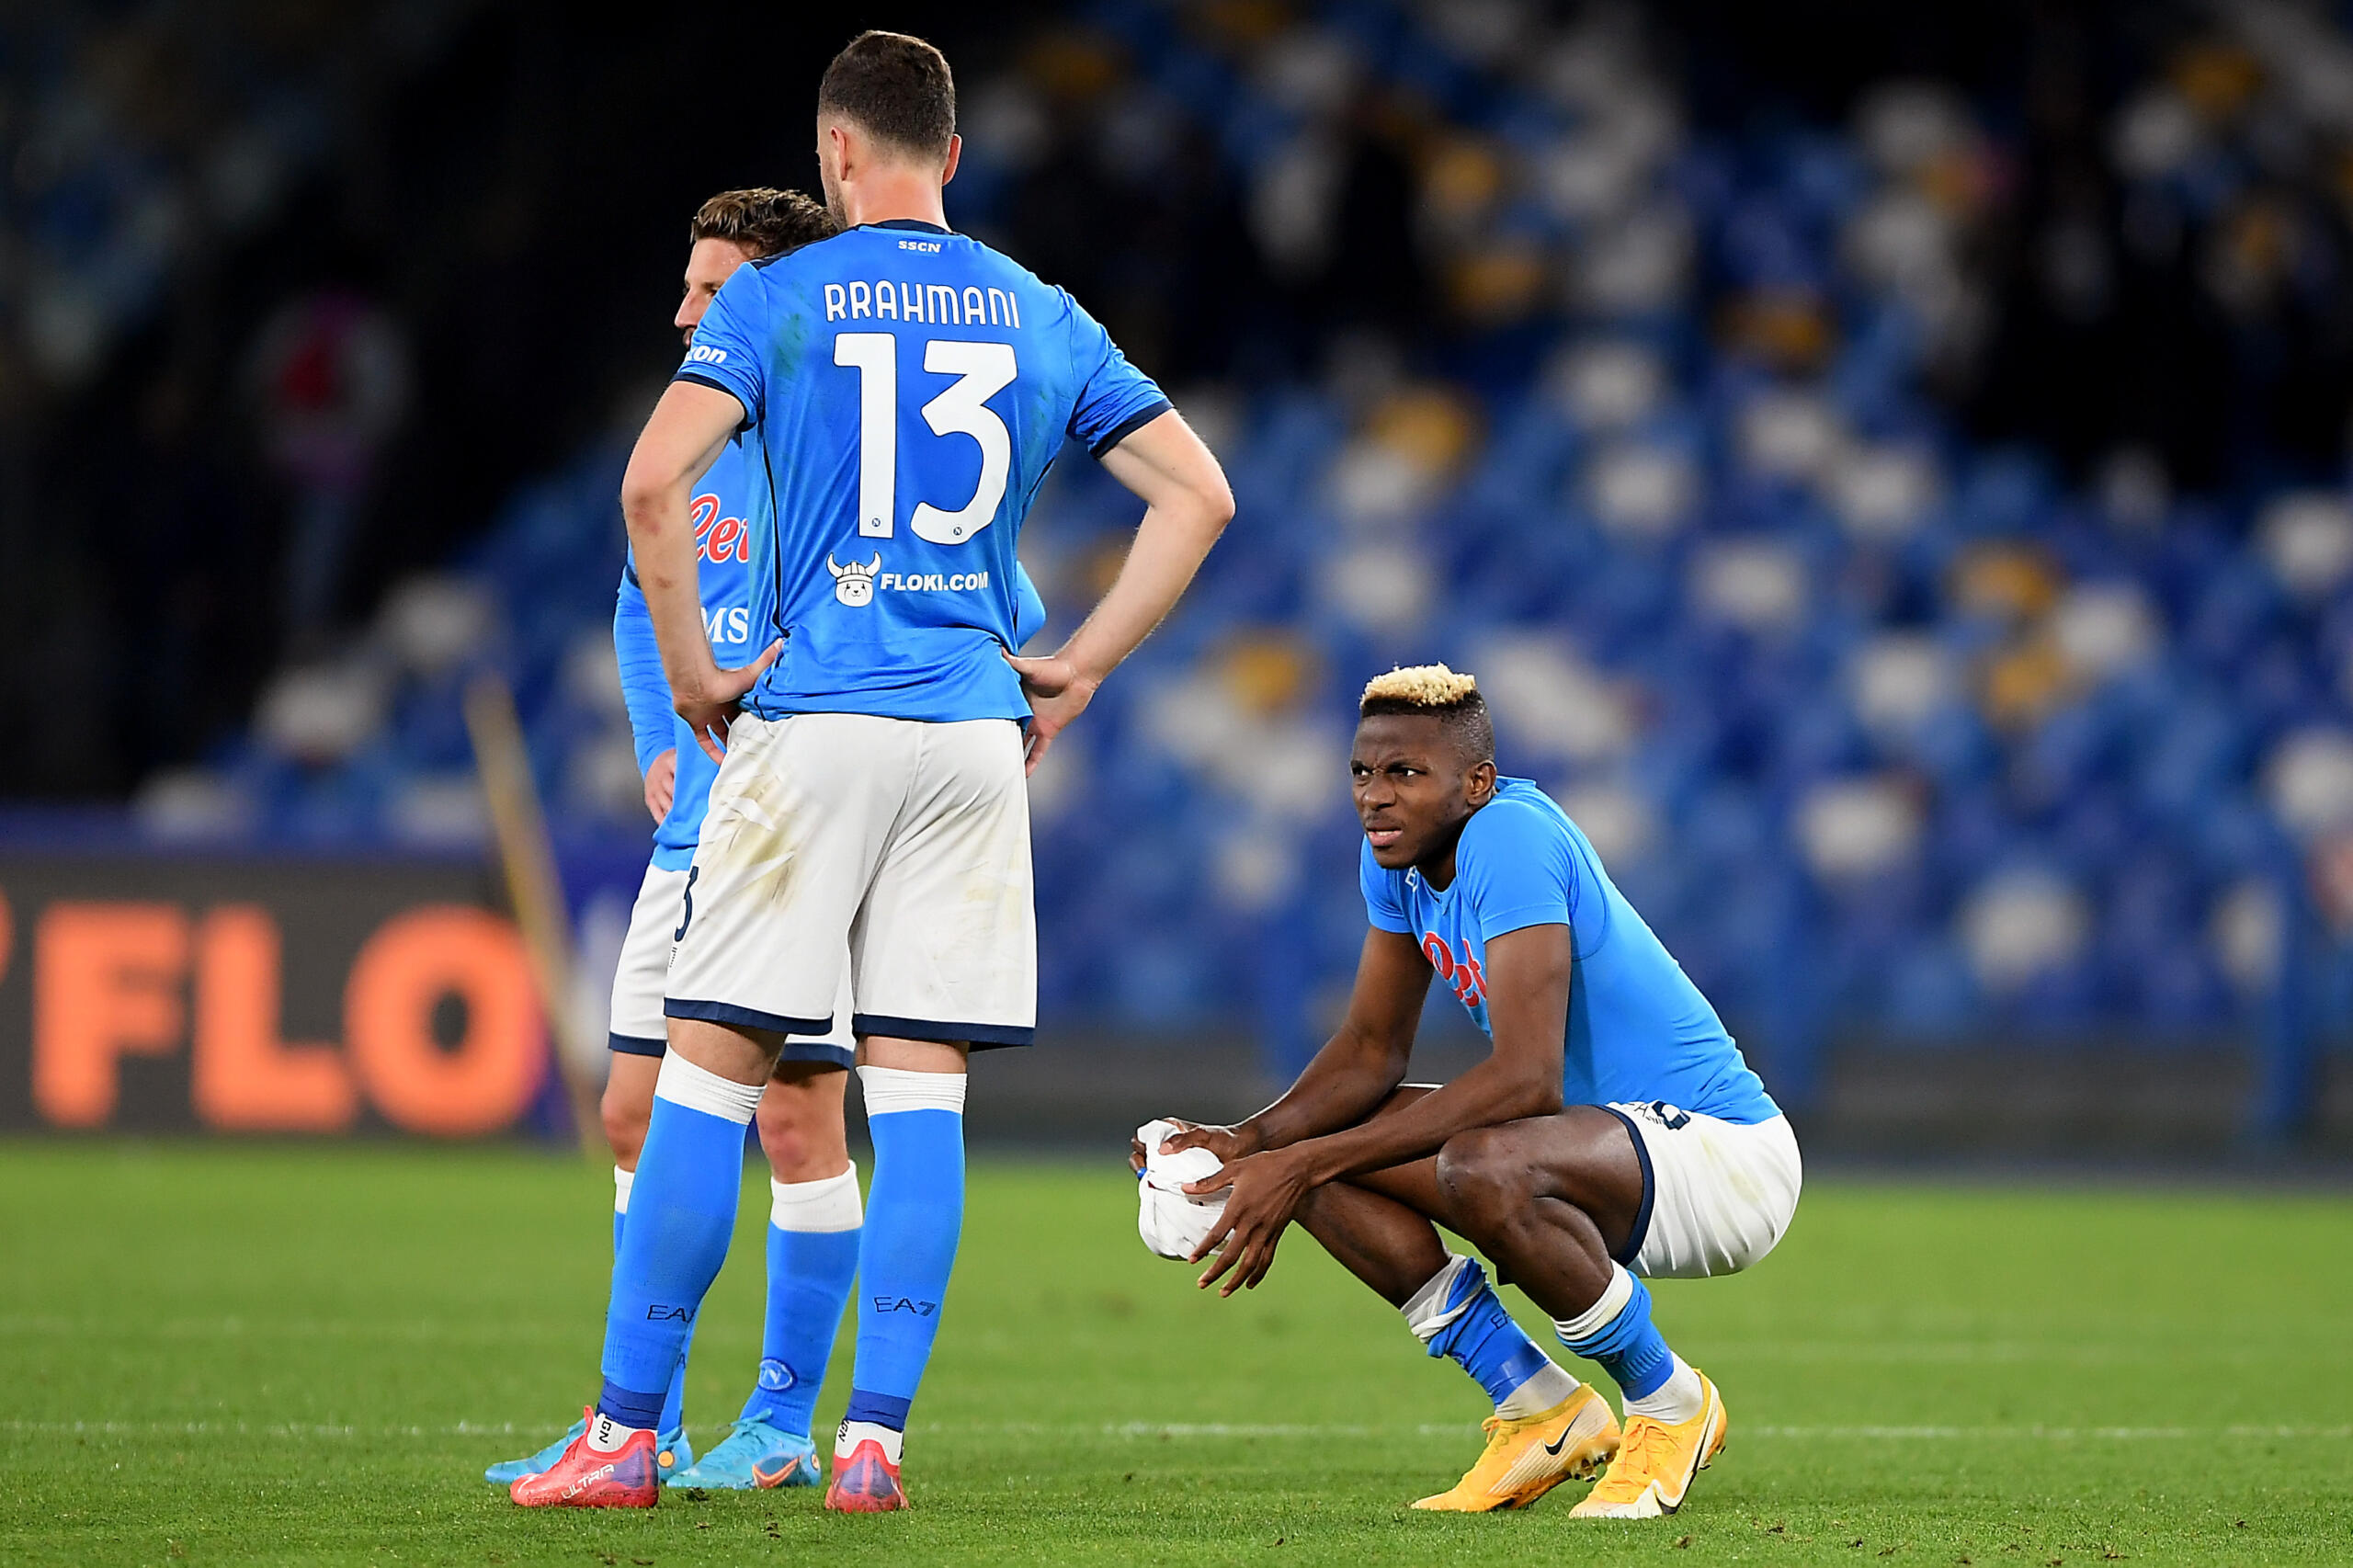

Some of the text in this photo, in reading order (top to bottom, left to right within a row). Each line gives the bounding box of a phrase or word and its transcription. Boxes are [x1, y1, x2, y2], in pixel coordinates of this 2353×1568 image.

[897, 240, 941, 254] SSCN
[824, 279, 1021, 330] RRAHMANI
[833, 332, 1018, 546] 13
[880, 571, 989, 592] FLOKI.COM
[874, 1296, 937, 1317] EA7
[561, 1463, 615, 1500] ULTRA
